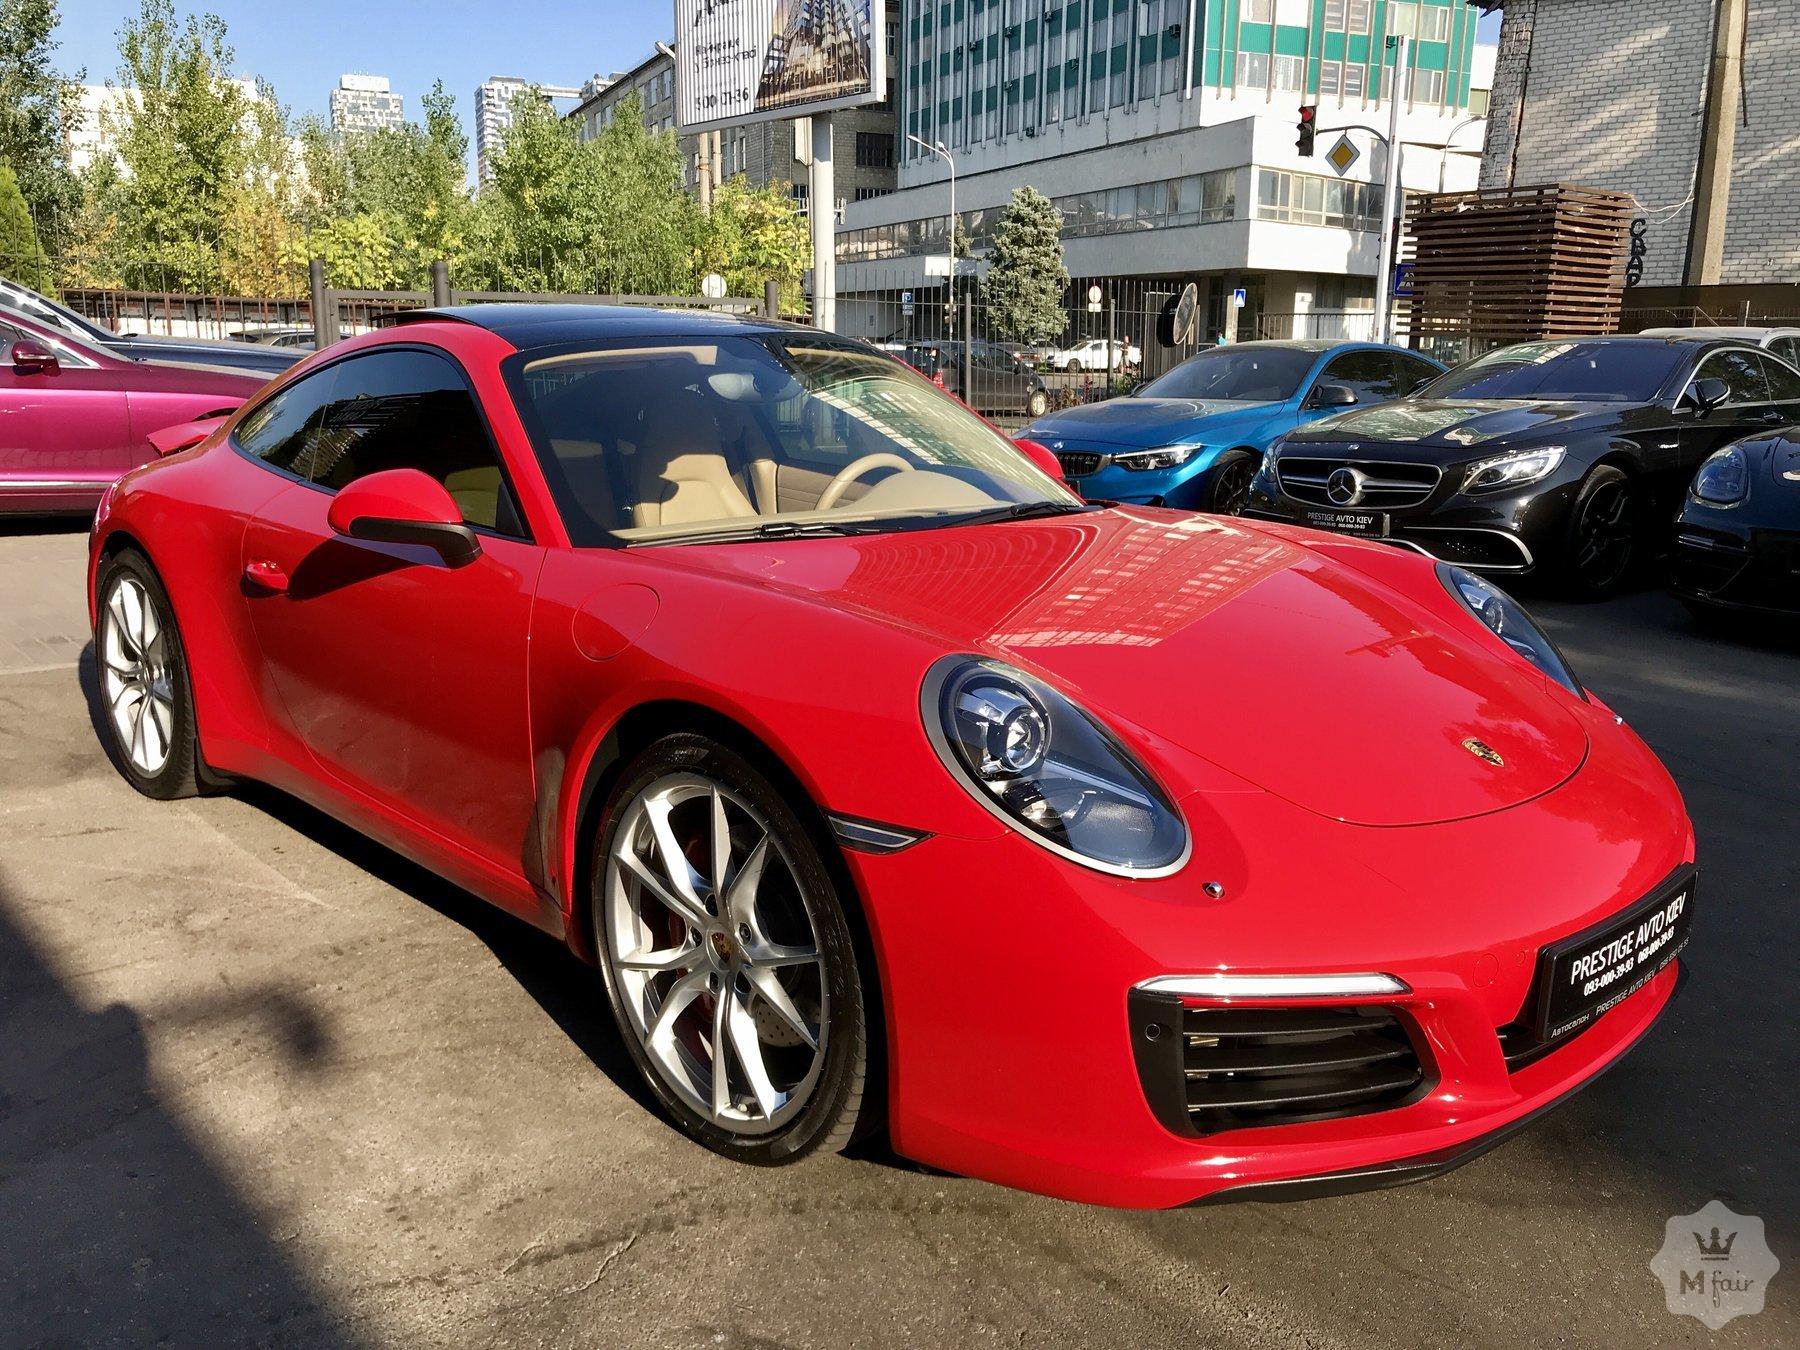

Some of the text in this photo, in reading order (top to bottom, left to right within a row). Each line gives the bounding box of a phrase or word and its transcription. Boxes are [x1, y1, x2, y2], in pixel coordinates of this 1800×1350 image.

[1307, 511, 1374, 525] PRESTIGE AVTO KIEV
[1570, 891, 1687, 985] PRESTIGE AVTO KIEV
[1583, 957, 1635, 997] 093-000-39-93
[1595, 989, 1629, 1017] PRESTIGE
[1627, 977, 1645, 997] AVTO
[1643, 967, 1657, 985] KIEV
